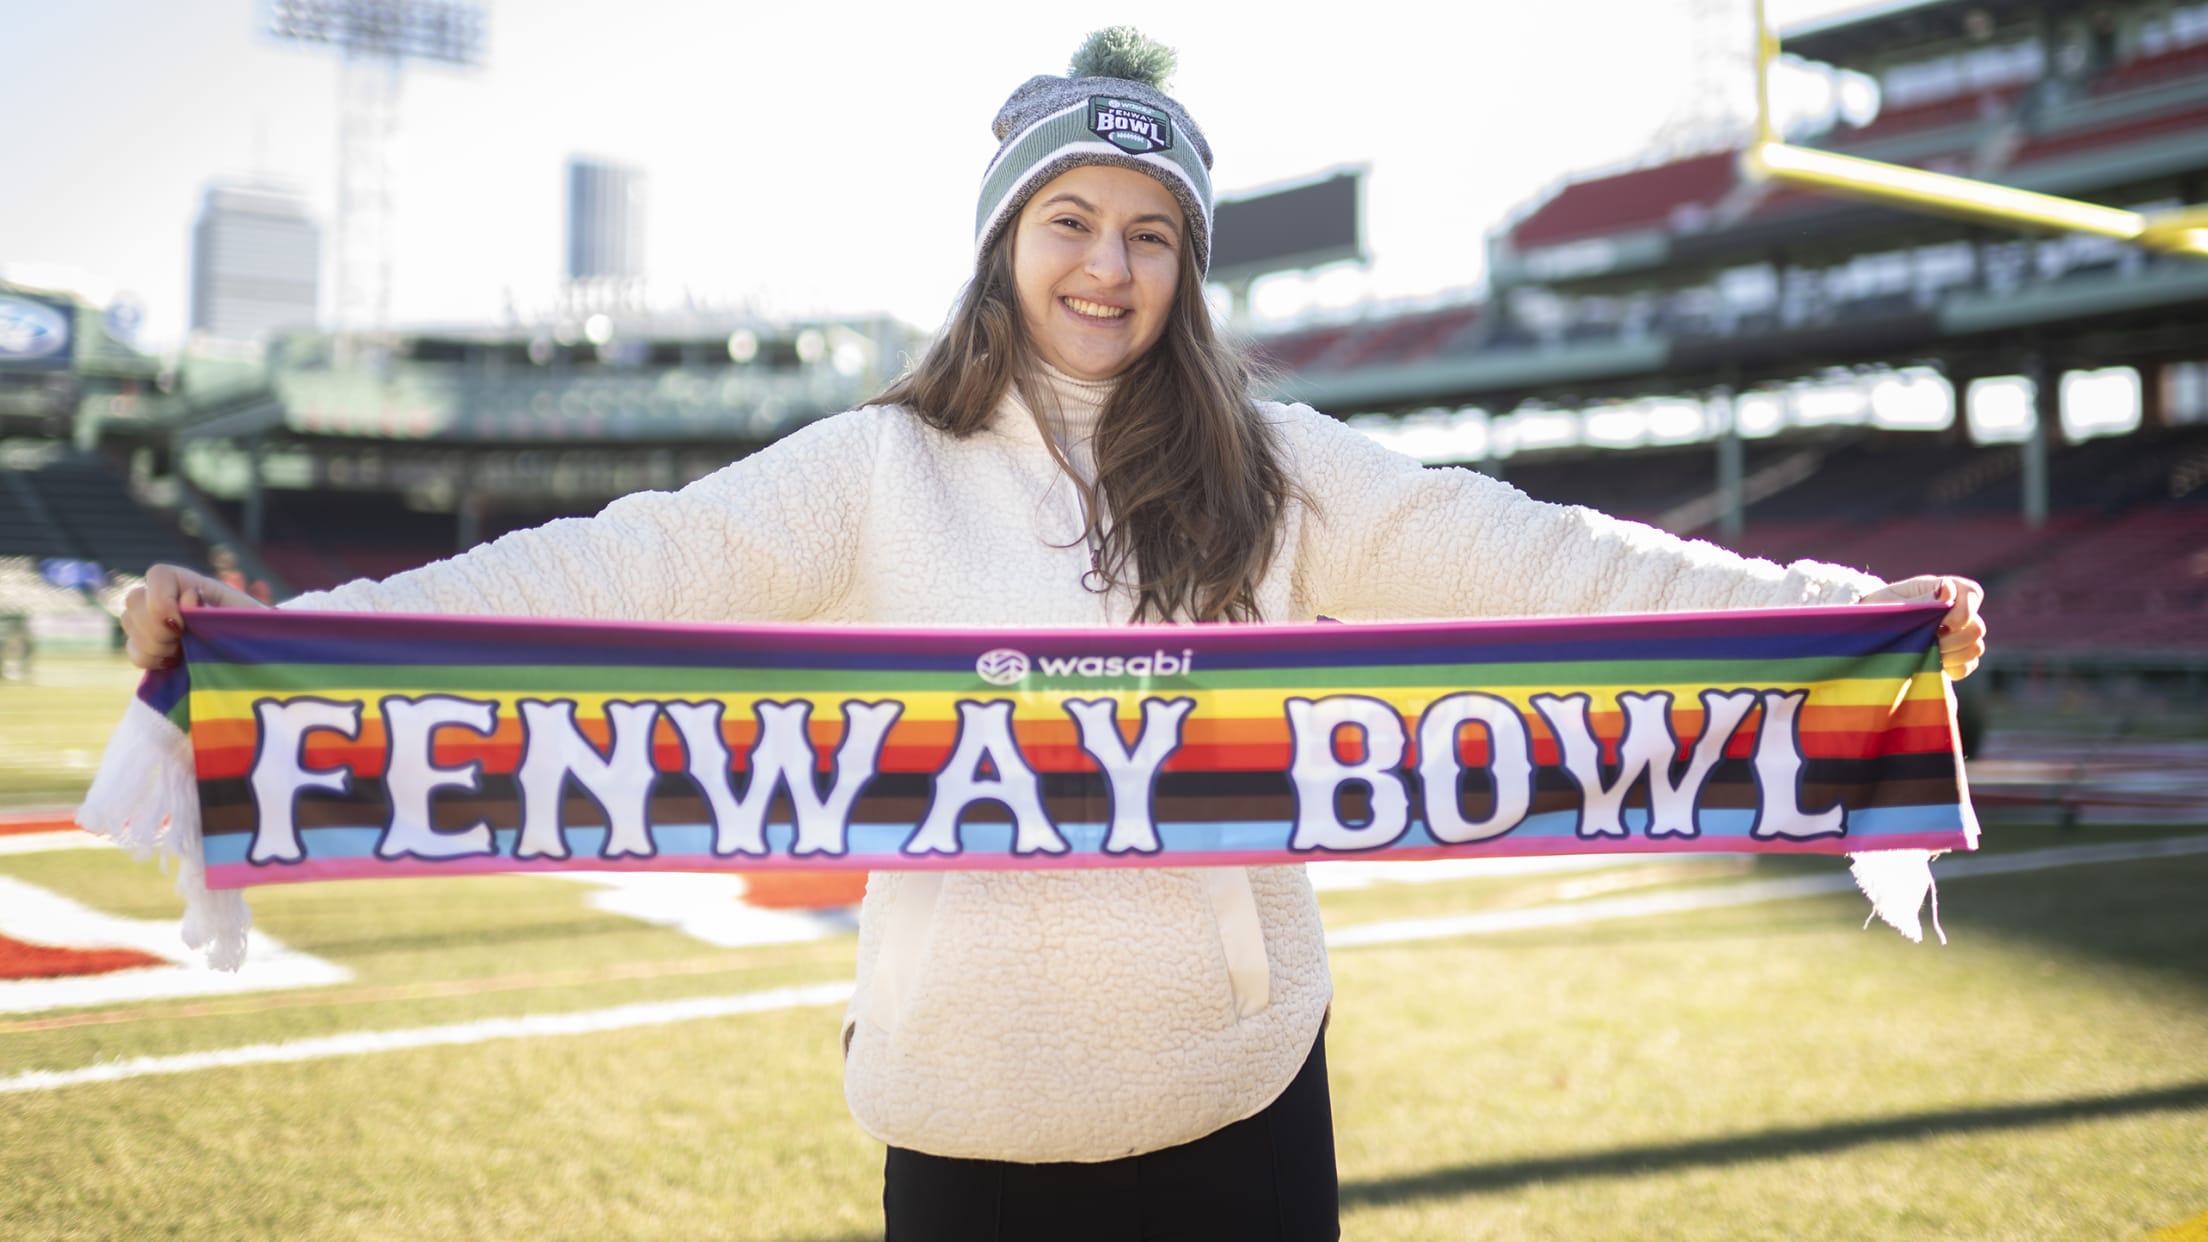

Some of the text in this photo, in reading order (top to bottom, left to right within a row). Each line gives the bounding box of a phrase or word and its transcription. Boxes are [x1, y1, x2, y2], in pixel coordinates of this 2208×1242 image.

[1097, 112, 1165, 146] BOWL
[1108, 108, 1154, 122] FENWAY
[1038, 649, 1194, 677] wasabi
[249, 688, 1847, 865] FENWAY BOWL
